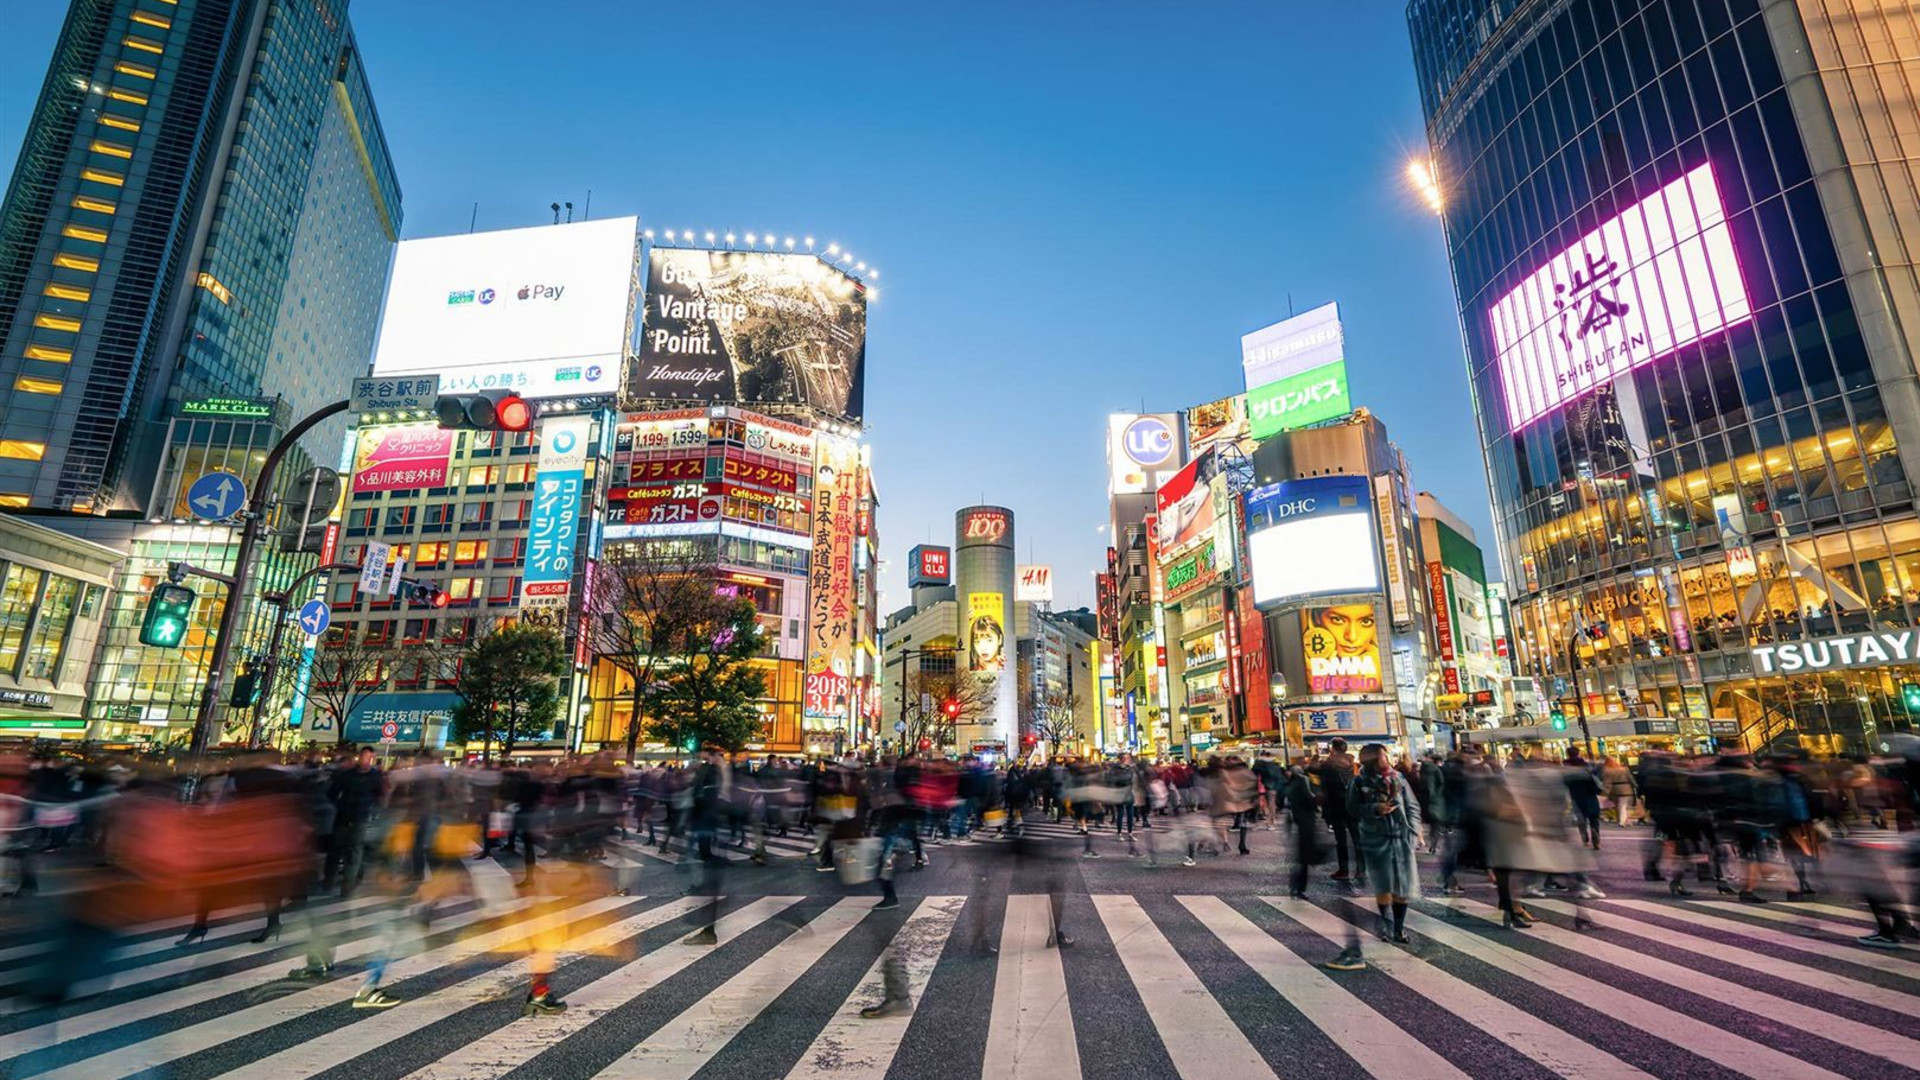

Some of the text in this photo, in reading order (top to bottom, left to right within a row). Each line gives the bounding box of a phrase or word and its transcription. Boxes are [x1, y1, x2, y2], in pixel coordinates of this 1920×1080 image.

[533, 284, 564, 301] Pay
[659, 294, 748, 326] Vantage
[653, 329, 717, 354] Point.
[1558, 332, 1645, 388] SHIBUTAN
[646, 364, 726, 387] HondaJet
[358, 380, 433, 398] 渋谷駅前
[184, 402, 229, 411] MARK
[367, 400, 401, 409] Shibuya
[1252, 379, 1342, 420] サロンパス
[401, 443, 442, 454] クリニック
[618, 434, 632, 443] 9F
[1129, 429, 1171, 454] UC
[545, 456, 579, 466] eyecity
[367, 469, 442, 485] 品川美容外科
[725, 460, 794, 487] コンタクト
[672, 483, 709, 499] ガスト
[650, 504, 694, 522] ガスト
[773, 495, 806, 512] ガスト
[1279, 498, 1316, 517] DHC
[609, 508, 626, 520] 7F
[532, 479, 561, 573] アイシティ
[553, 479, 578, 572] コンタクトの
[966, 518, 1005, 542] 109
[1380, 490, 1399, 584] Taisei neon
[830, 469, 852, 638] 打首獄門同好会が
[925, 554, 943, 564] UNI
[812, 490, 833, 649] 日本武道館だって。
[925, 564, 944, 574] QLO
[1753, 632, 1920, 672] TSUTAY
[1311, 655, 1377, 676] DMM
[807, 675, 848, 696] 2018
[1313, 674, 1377, 692] Bitcoin
